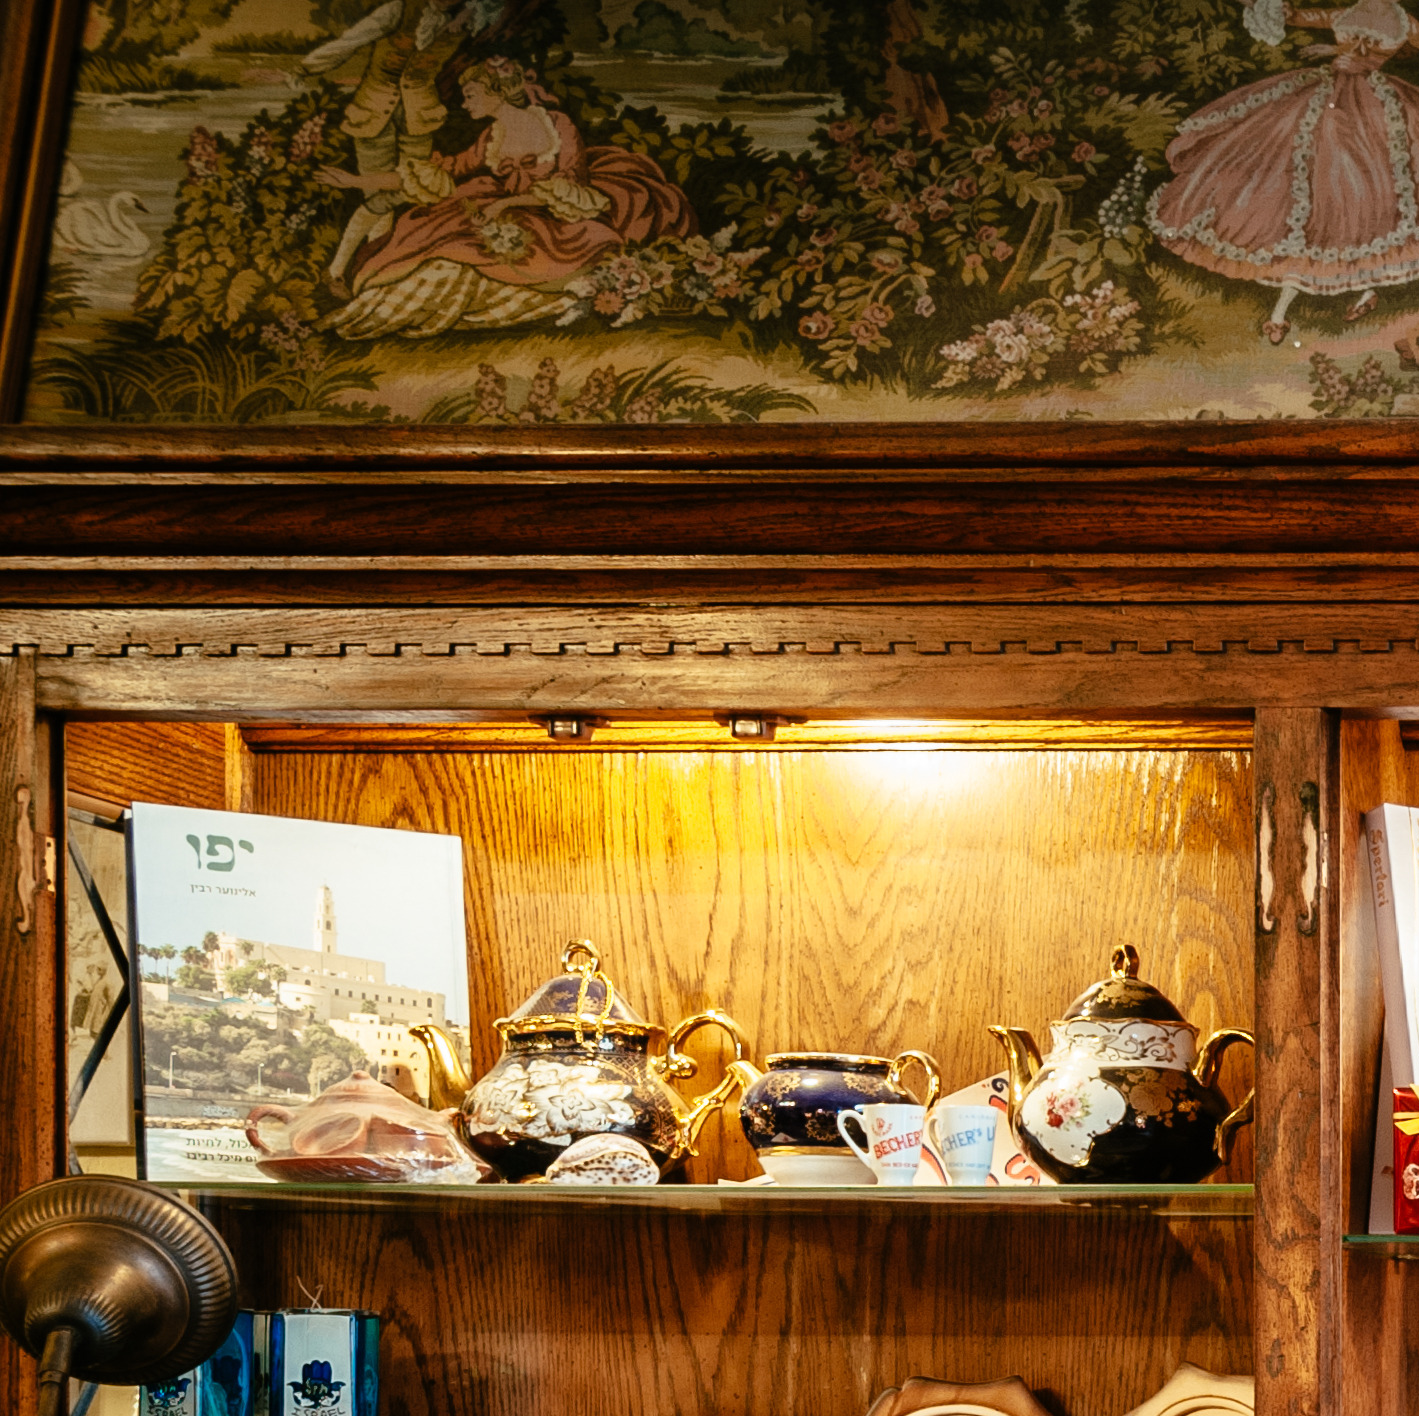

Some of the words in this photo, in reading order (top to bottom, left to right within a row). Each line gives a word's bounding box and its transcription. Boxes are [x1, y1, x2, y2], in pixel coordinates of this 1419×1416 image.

[186, 833, 254, 872] יפו
[190, 883, 212, 894] רבין
[216, 885, 256, 898] אלינוער
